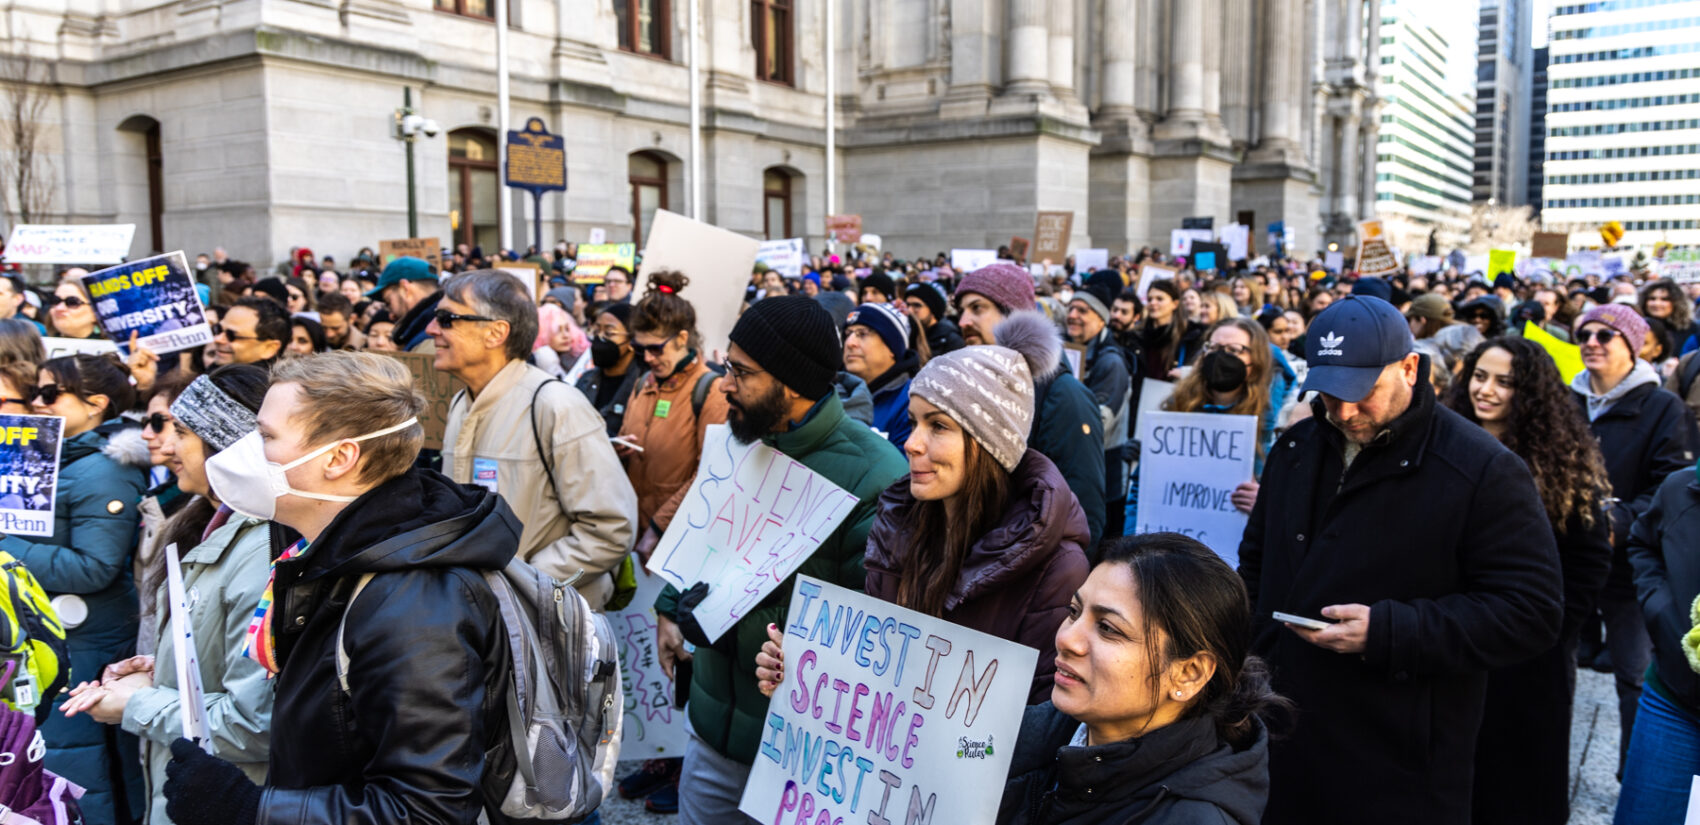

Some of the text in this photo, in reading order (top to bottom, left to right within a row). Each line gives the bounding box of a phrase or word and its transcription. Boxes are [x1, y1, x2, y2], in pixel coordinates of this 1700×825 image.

[131, 264, 170, 287] OFF
[168, 331, 207, 348] Penn
[1318, 347, 1343, 357] adidas
[1149, 425, 1244, 461] SCIENCE
[708, 431, 860, 544] SCIENCE
[5, 511, 46, 532] Penn
[787, 580, 999, 728] INVEST IN
[648, 680, 670, 710] Did
[790, 649, 924, 768] SCIENCE
[962, 736, 986, 749] Science
[965, 747, 985, 760] Rules
[761, 711, 937, 825] INVEST IN
[773, 779, 844, 825] PR
